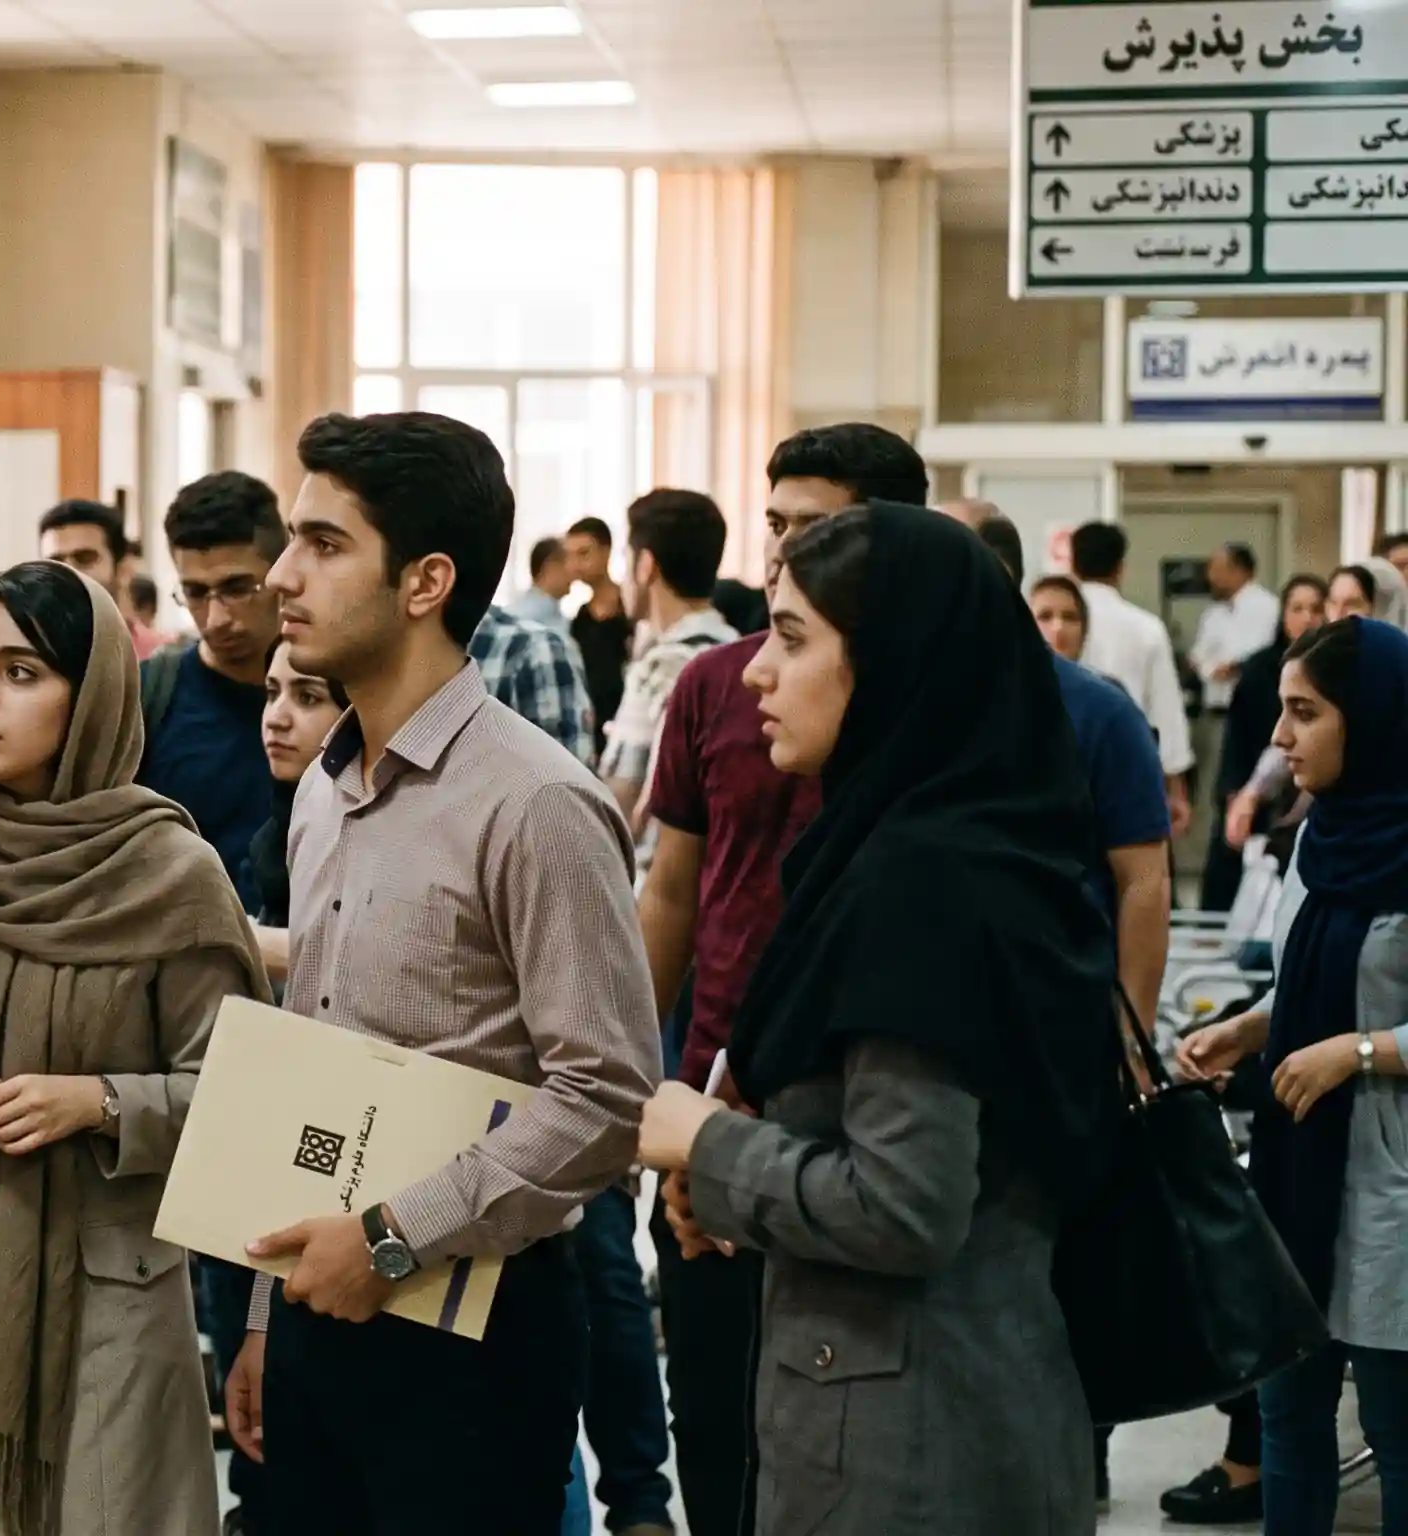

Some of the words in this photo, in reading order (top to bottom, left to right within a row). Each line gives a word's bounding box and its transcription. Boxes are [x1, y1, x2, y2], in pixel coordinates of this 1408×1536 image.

[1103, 13, 1244, 73] پذیرش
[1259, 12, 1363, 69] بخش
[1154, 120, 1242, 155] پزشکی
[1092, 177, 1241, 213] دندانپزشکی
[357, 1105, 377, 1148] دانشگاه
[351, 1149, 364, 1176] علوم
[339, 1176, 362, 1213] پزشکی
